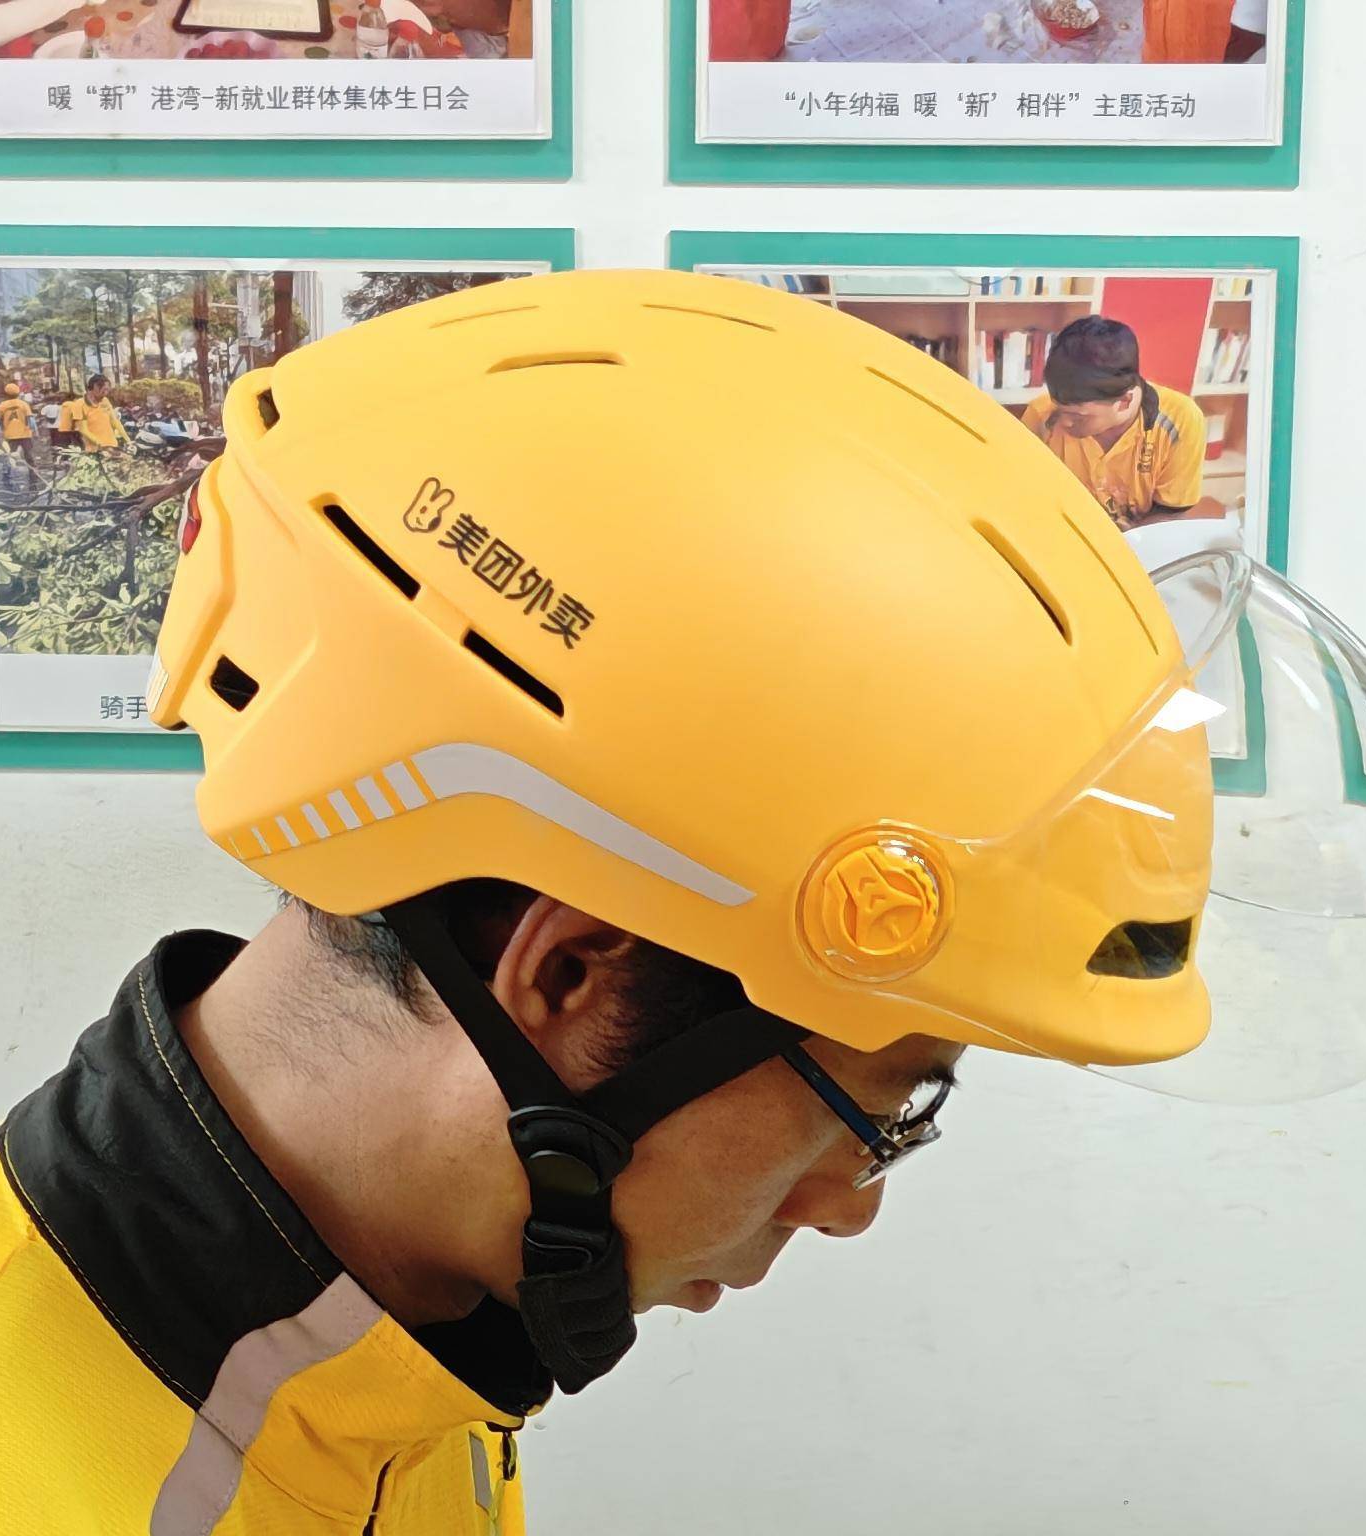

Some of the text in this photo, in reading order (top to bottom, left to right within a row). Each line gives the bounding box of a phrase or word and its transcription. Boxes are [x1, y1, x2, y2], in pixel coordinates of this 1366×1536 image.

[437, 513, 595, 650] 美团外卖
[100, 695, 149, 720] 骑手
